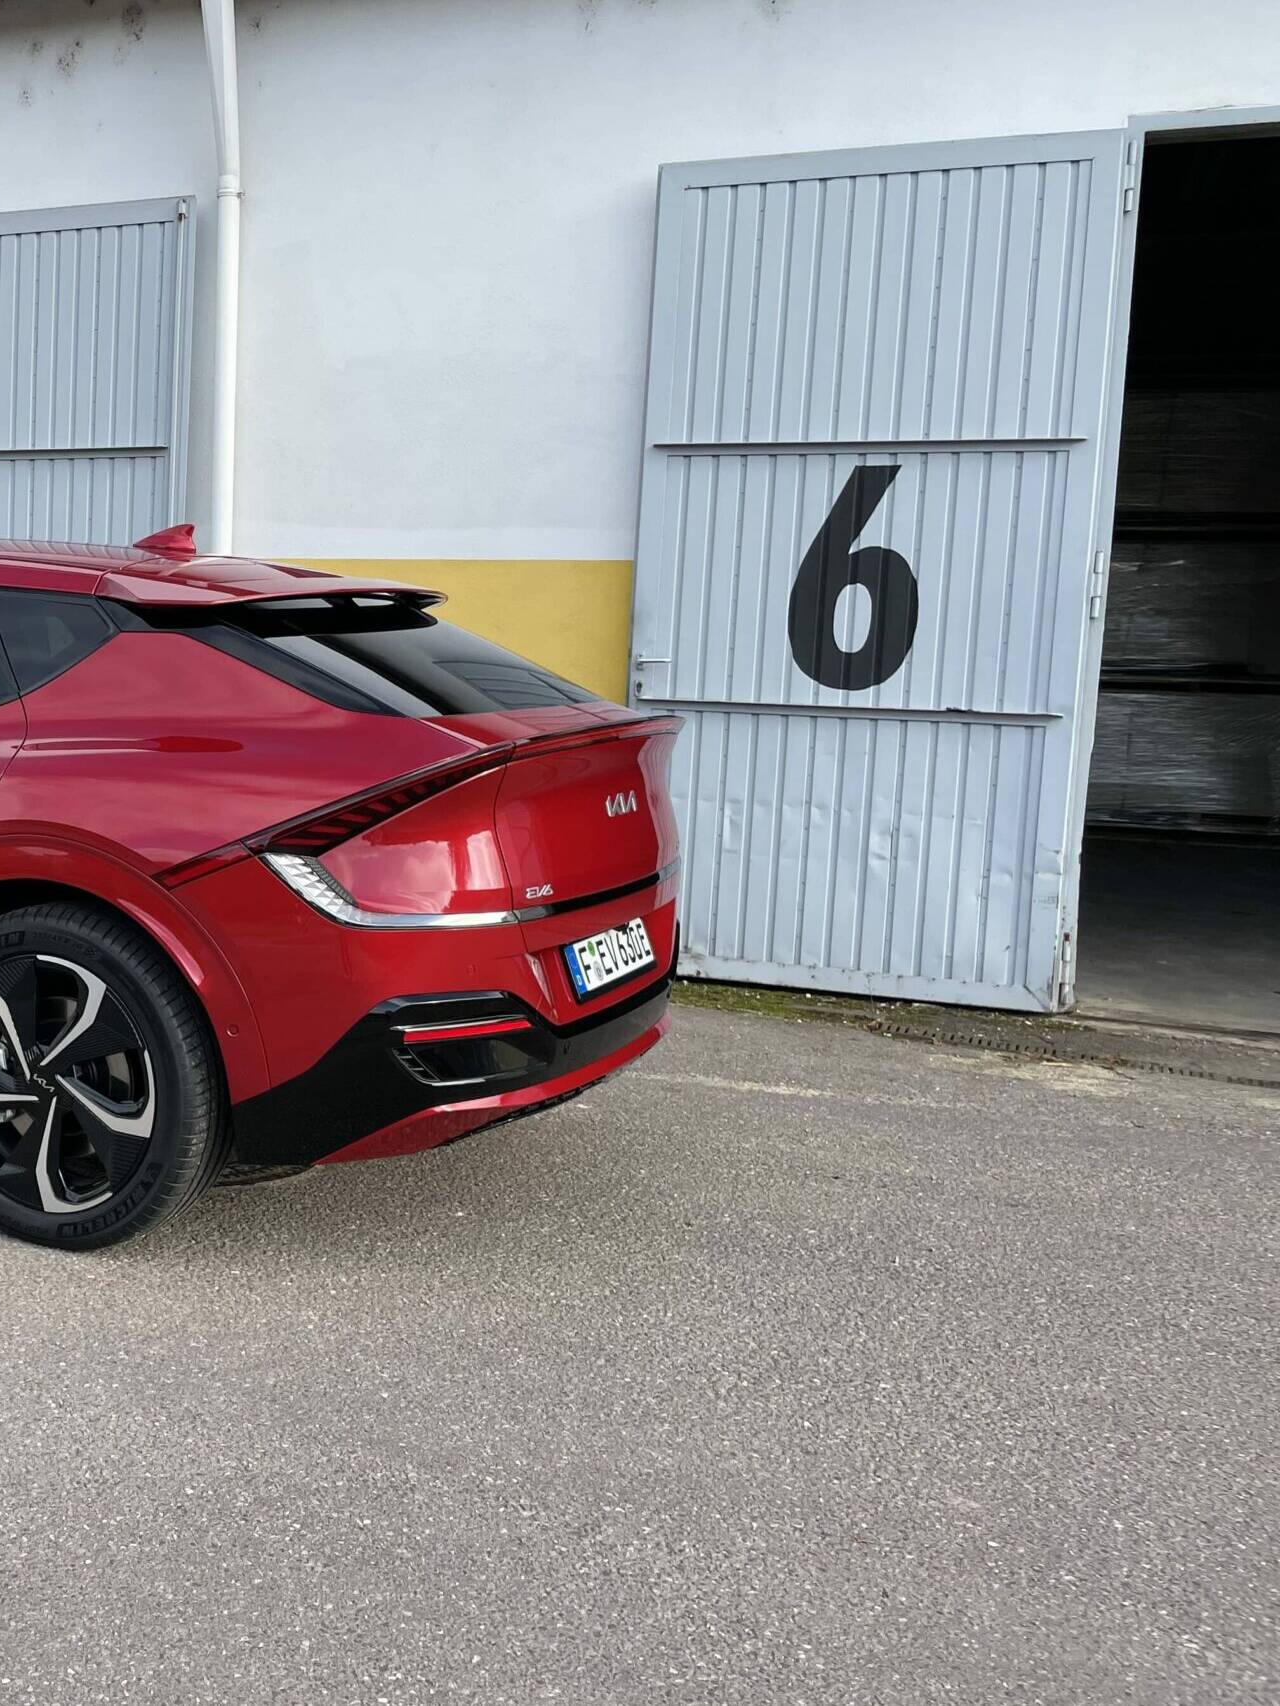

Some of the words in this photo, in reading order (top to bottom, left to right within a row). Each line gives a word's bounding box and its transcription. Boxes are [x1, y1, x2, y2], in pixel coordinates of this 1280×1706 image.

[787, 464, 919, 691] 6
[605, 790, 637, 817] KIA
[526, 884, 554, 899] EV6
[578, 946, 591, 984] F
